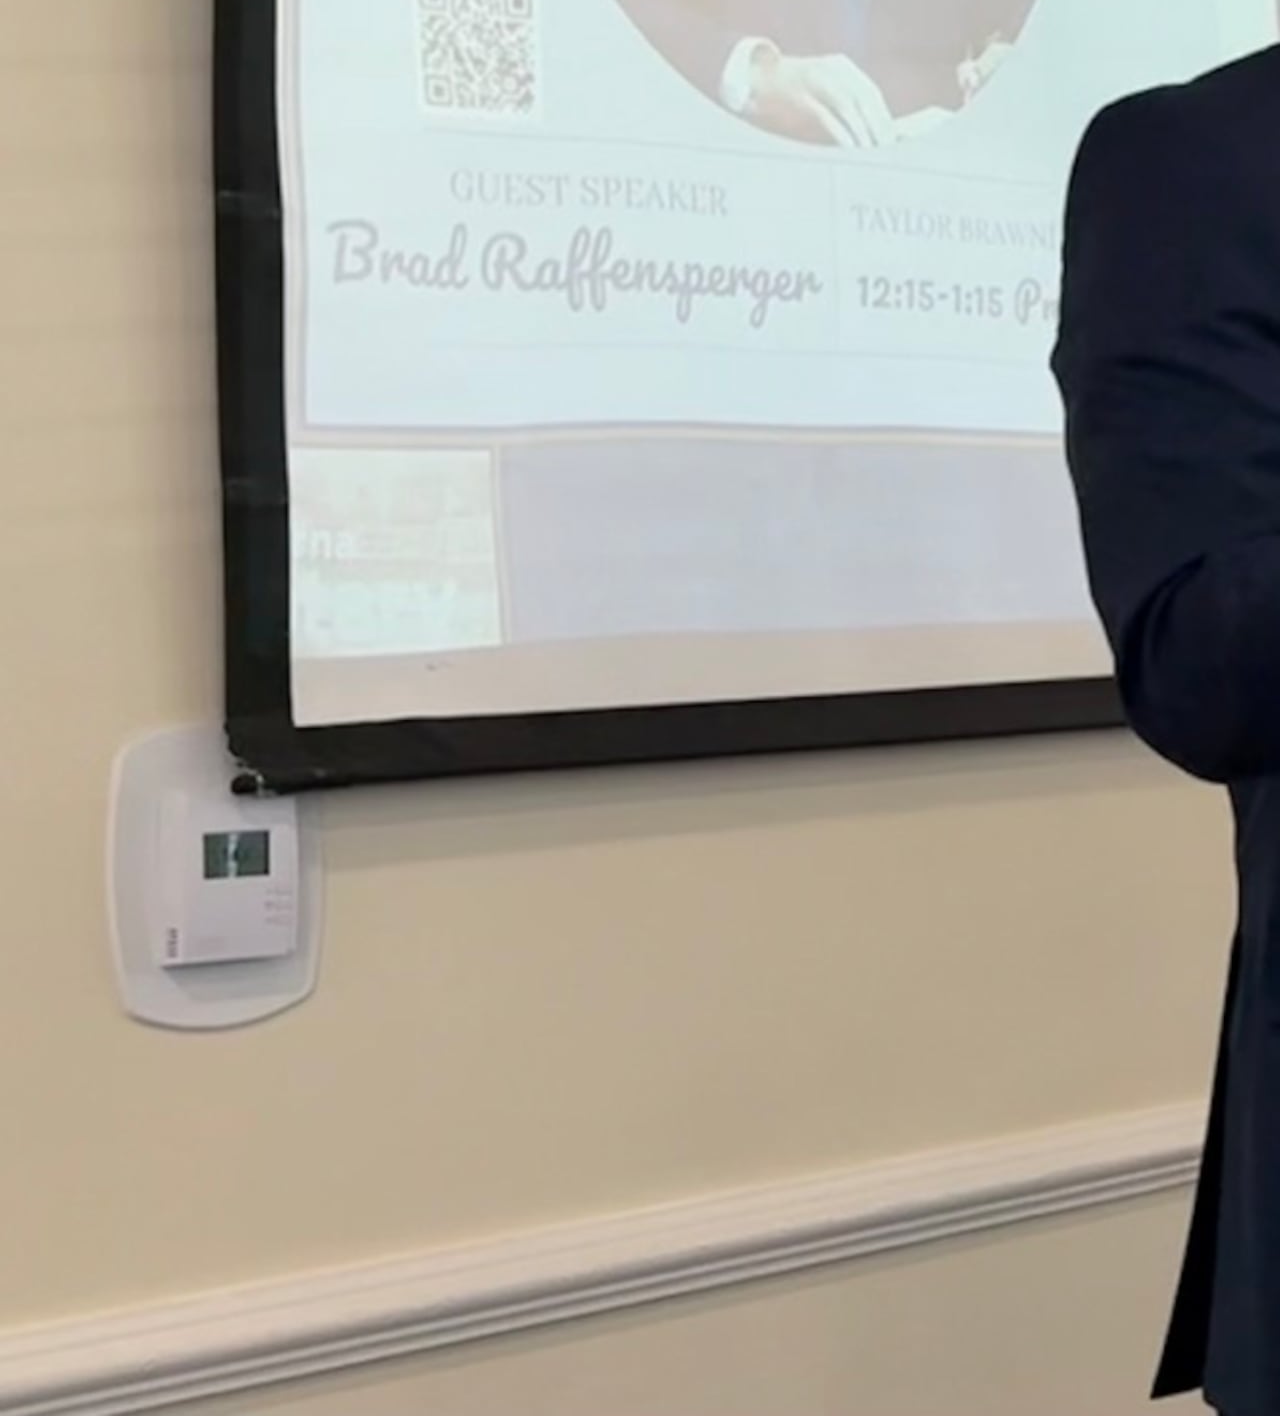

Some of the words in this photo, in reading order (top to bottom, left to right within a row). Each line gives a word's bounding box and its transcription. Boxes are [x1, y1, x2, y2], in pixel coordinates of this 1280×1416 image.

[449, 169, 570, 207] GUEST
[579, 175, 728, 216] SPEAKER
[851, 204, 953, 240] TAYLOR
[326, 218, 469, 289] Brad
[481, 226, 823, 329] Raffensperger
[857, 276, 1004, 318] 12:15-1:15
